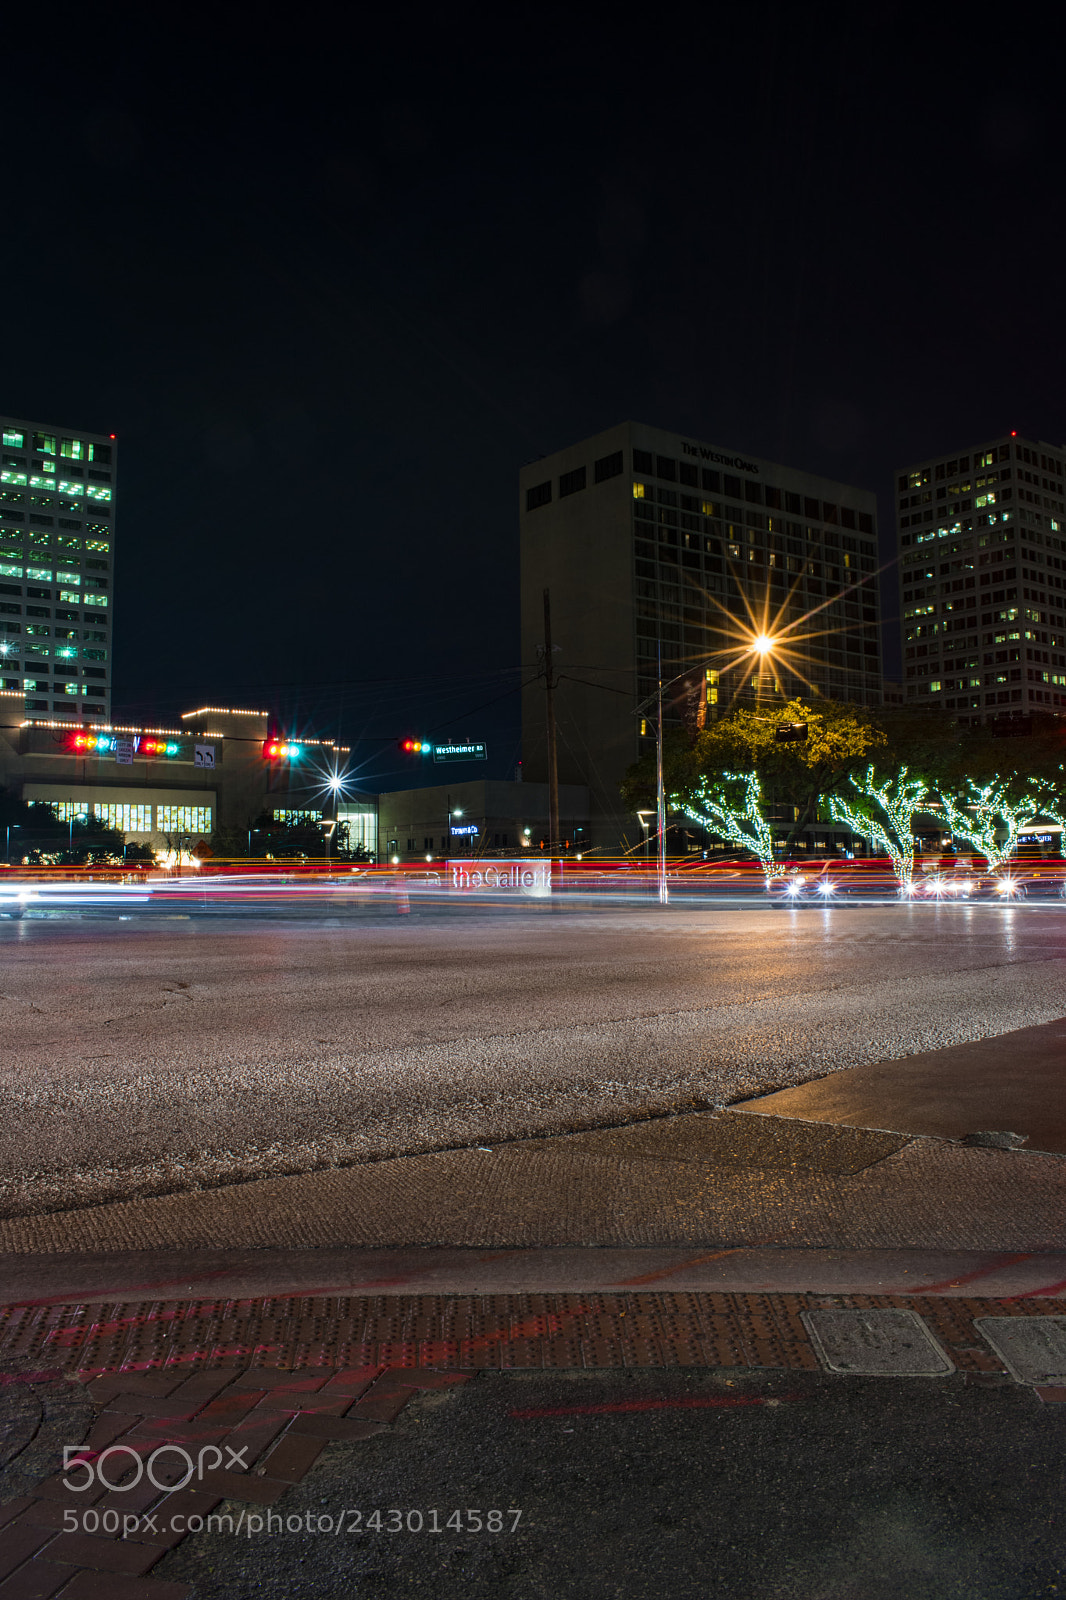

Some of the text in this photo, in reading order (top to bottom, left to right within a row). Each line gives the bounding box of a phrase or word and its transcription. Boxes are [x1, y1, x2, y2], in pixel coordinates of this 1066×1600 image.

[681, 441, 759, 474] THE WESTIN OAKS
[436, 745, 475, 755] Westheimer
